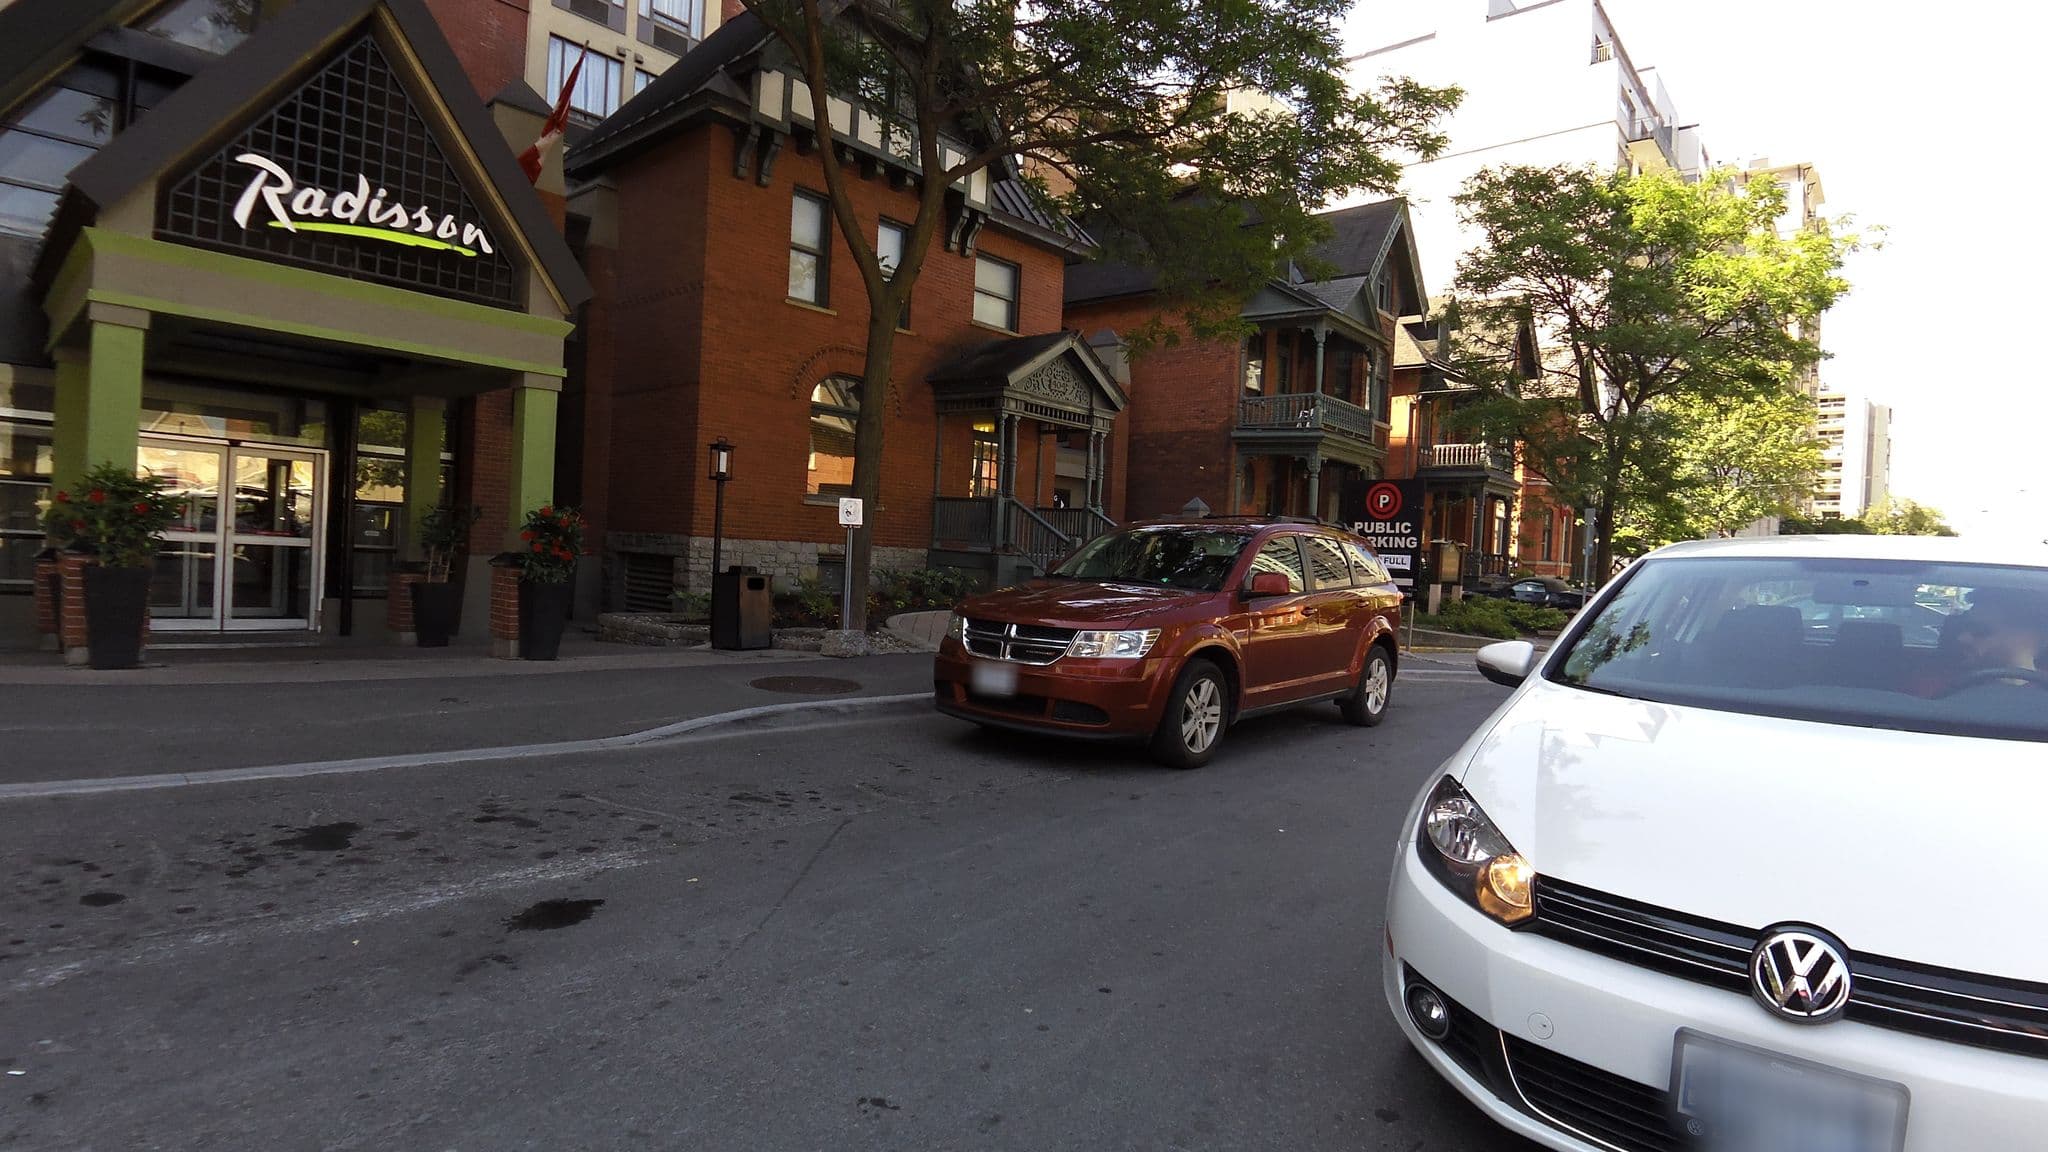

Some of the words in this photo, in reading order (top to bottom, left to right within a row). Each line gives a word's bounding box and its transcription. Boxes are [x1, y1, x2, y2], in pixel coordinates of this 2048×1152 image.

[233, 153, 493, 254] Radisson
[1379, 494, 1390, 508] P
[1354, 522, 1412, 534] PUBLIC
[1366, 536, 1418, 549] RKING
[1383, 556, 1407, 565] FULL
